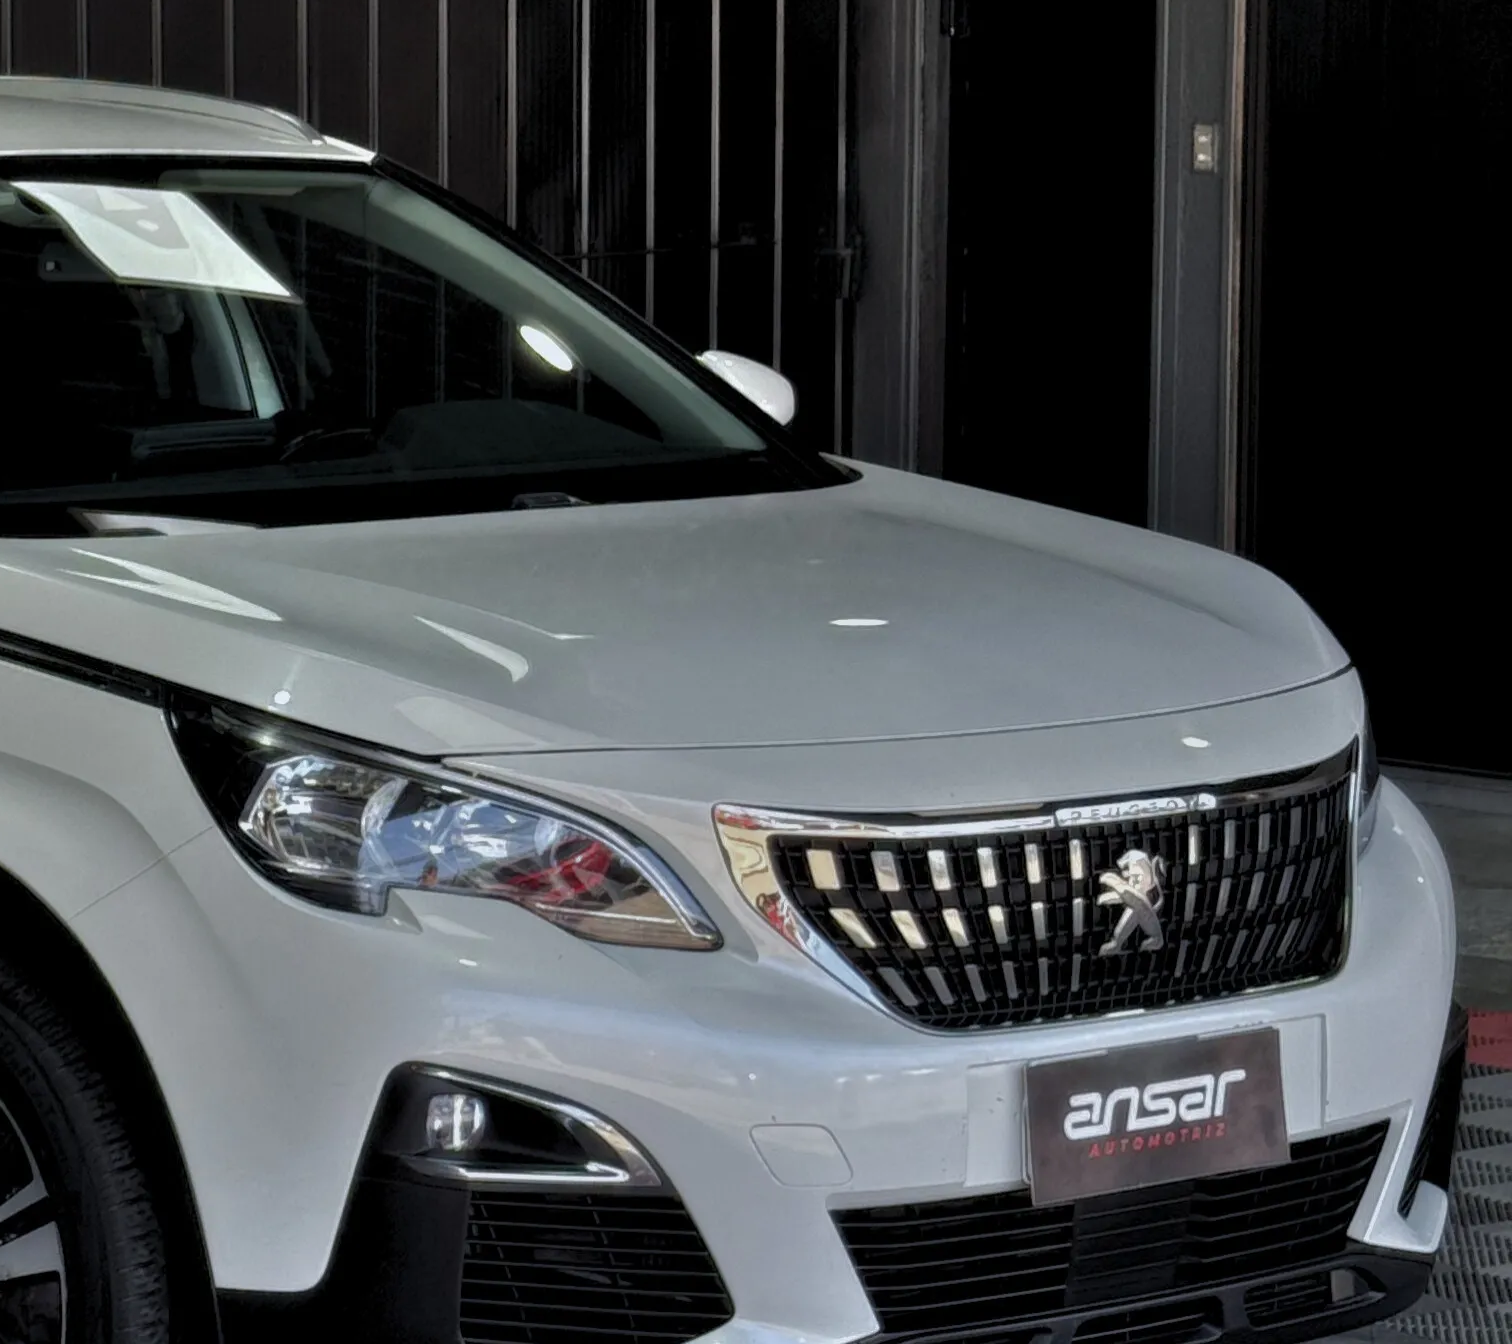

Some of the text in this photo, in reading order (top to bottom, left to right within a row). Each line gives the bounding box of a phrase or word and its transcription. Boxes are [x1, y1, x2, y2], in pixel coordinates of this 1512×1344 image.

[1070, 798, 1199, 821] PEUGEO
[1063, 1068, 1247, 1141] ansar
[1088, 1121, 1228, 1158] AUTOMOTRIZ
